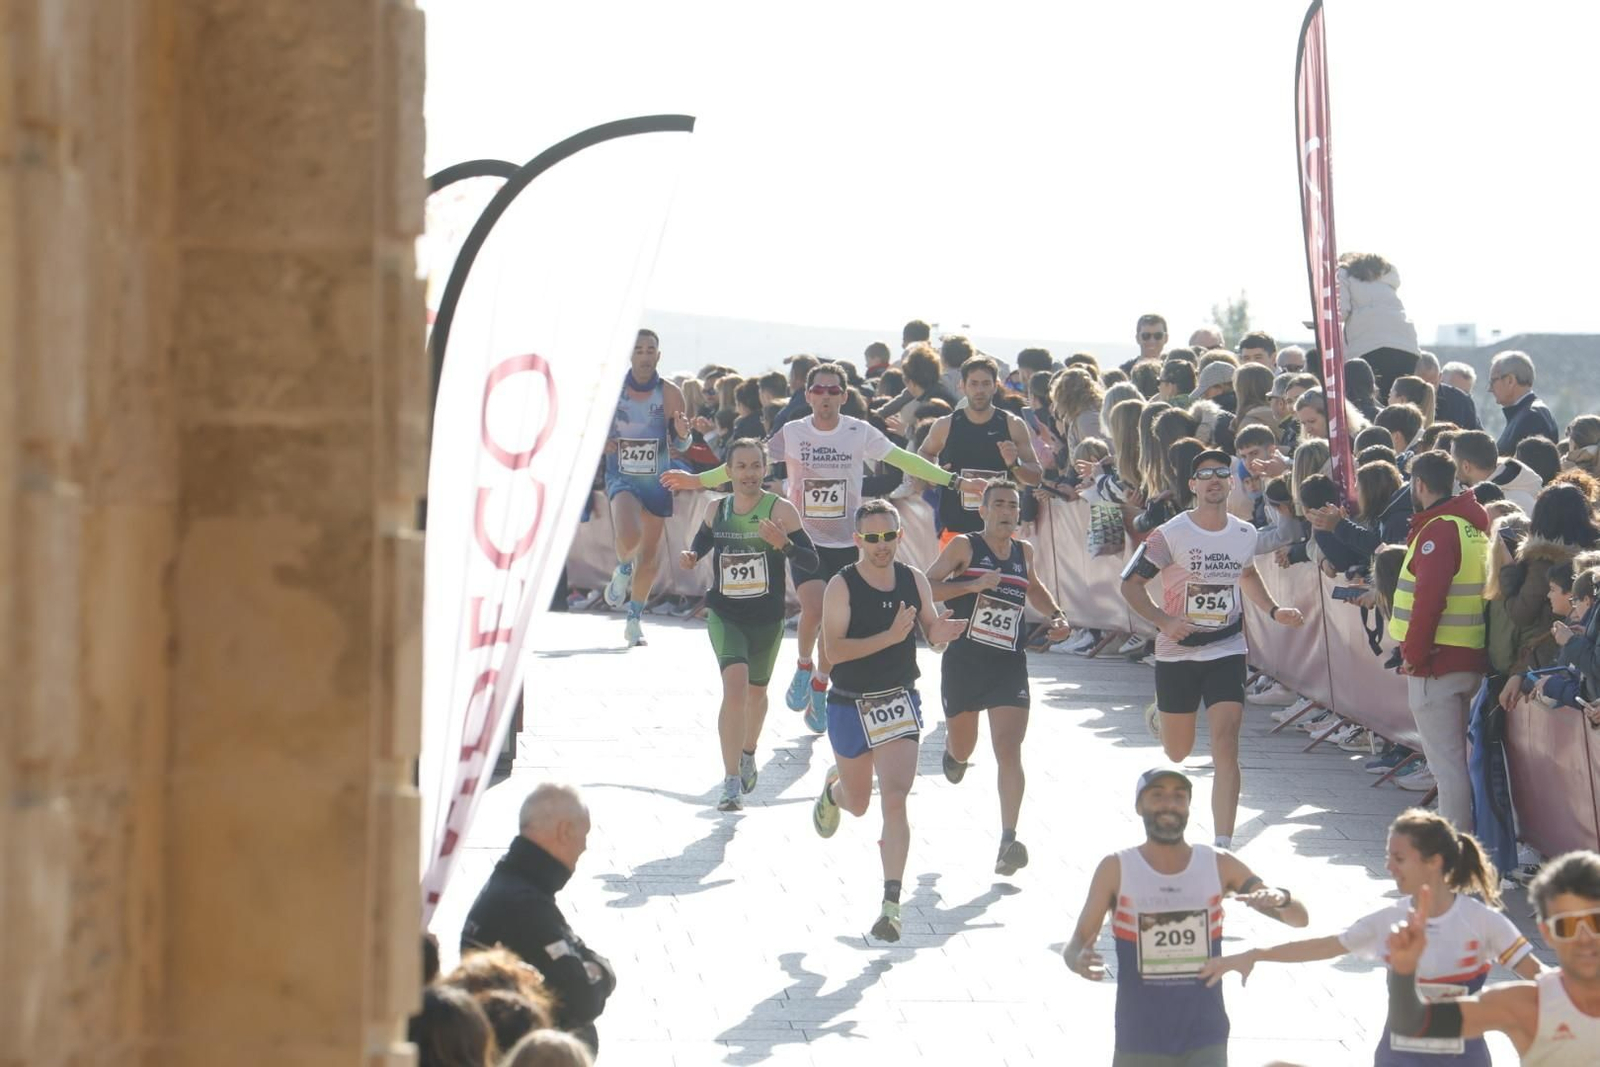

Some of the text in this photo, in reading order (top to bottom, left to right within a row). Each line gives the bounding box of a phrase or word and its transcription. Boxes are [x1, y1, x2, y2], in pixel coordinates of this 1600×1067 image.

[622, 449, 655, 461] 2470
[812, 451, 852, 461] MARATÓN
[811, 490, 838, 503] 976
[1204, 553, 1230, 561] MEDIA
[1190, 561, 1202, 570] 37
[730, 566, 756, 580] 991
[1195, 596, 1227, 610] 954
[980, 611, 1012, 631] 265
[869, 705, 905, 725] 1019
[1154, 929, 1195, 947] 209
